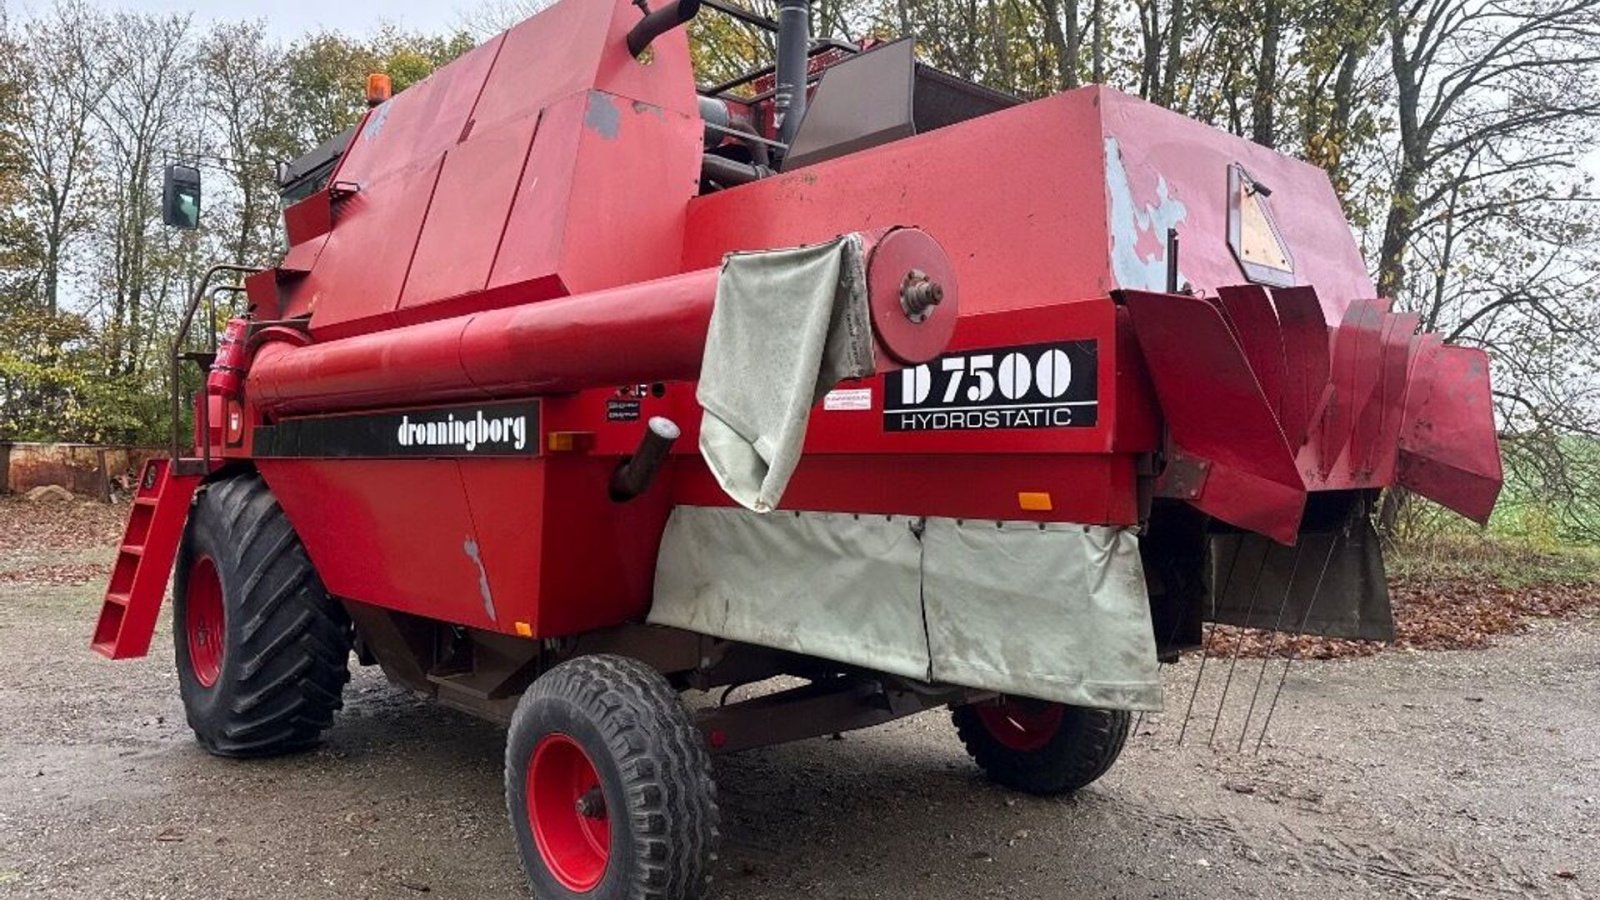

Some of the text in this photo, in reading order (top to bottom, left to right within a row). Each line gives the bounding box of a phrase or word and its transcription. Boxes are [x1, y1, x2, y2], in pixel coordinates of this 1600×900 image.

[902, 348, 1072, 405] D 7500
[397, 411, 526, 451] dronningborg
[901, 407, 1072, 430] HYDROSTATIC
